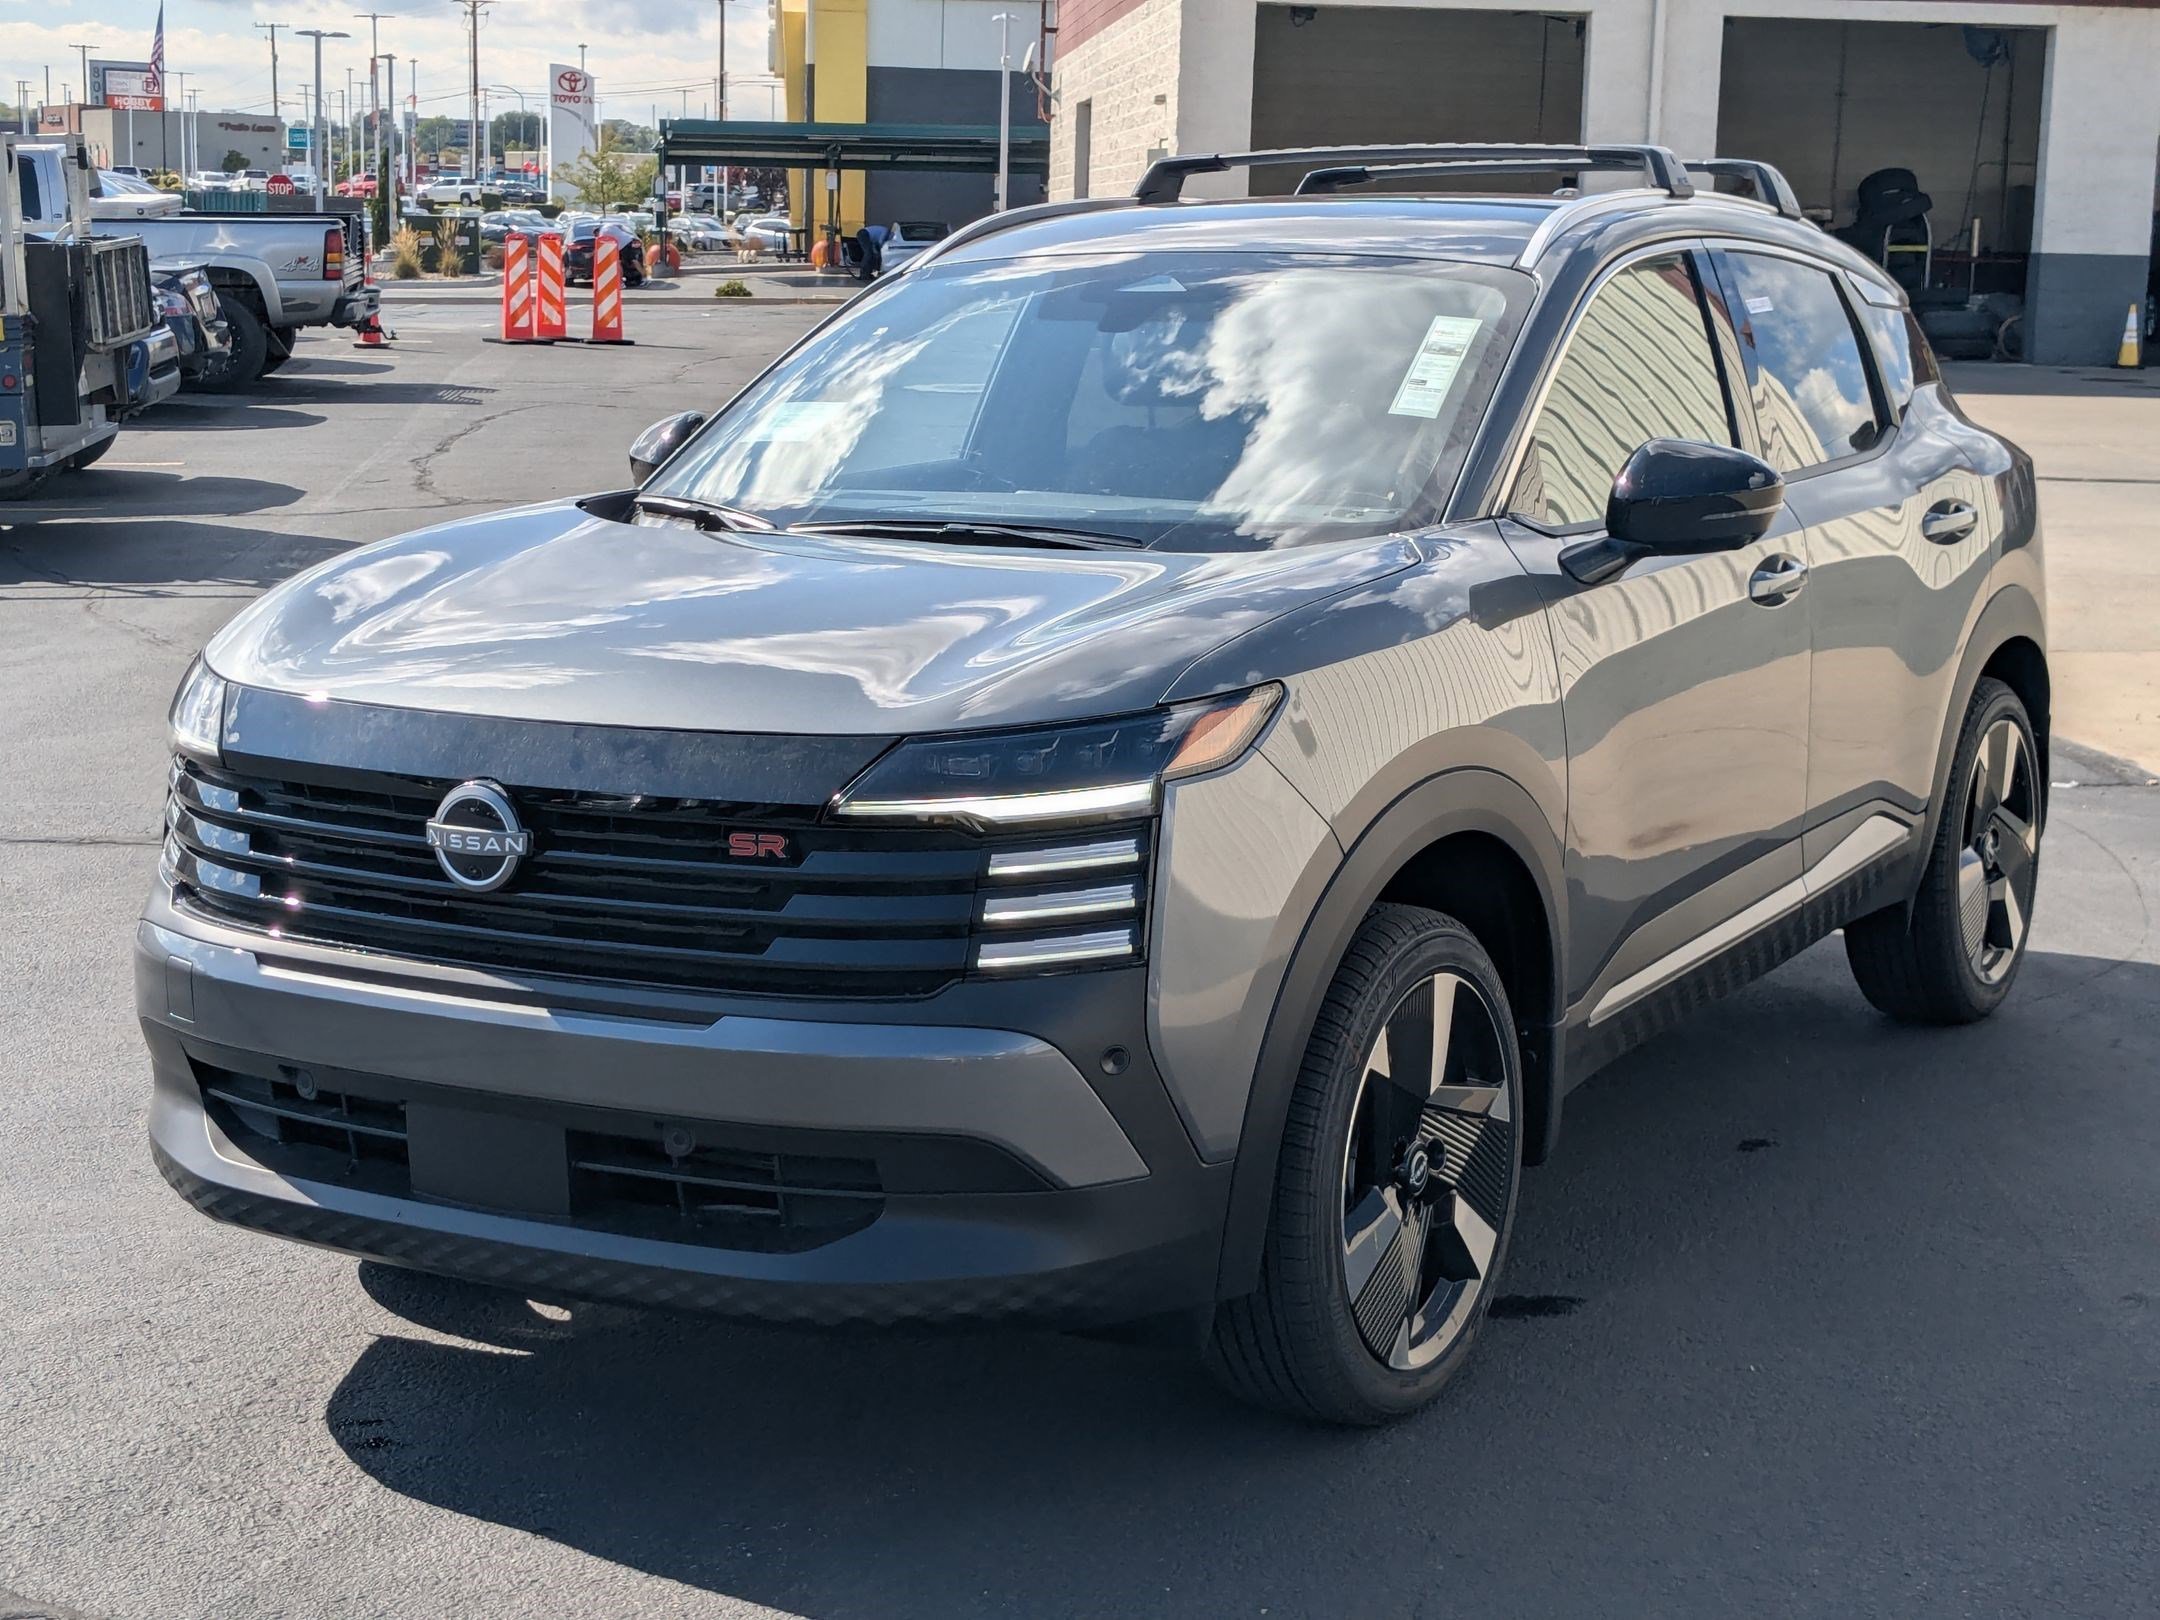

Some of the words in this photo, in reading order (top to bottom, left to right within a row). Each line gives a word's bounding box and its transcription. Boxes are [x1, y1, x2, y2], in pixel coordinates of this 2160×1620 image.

[114, 96, 152, 107] HOBBY
[268, 182, 293, 195] STOP
[427, 828, 523, 852] NISSAN
[729, 833, 787, 858] SR
